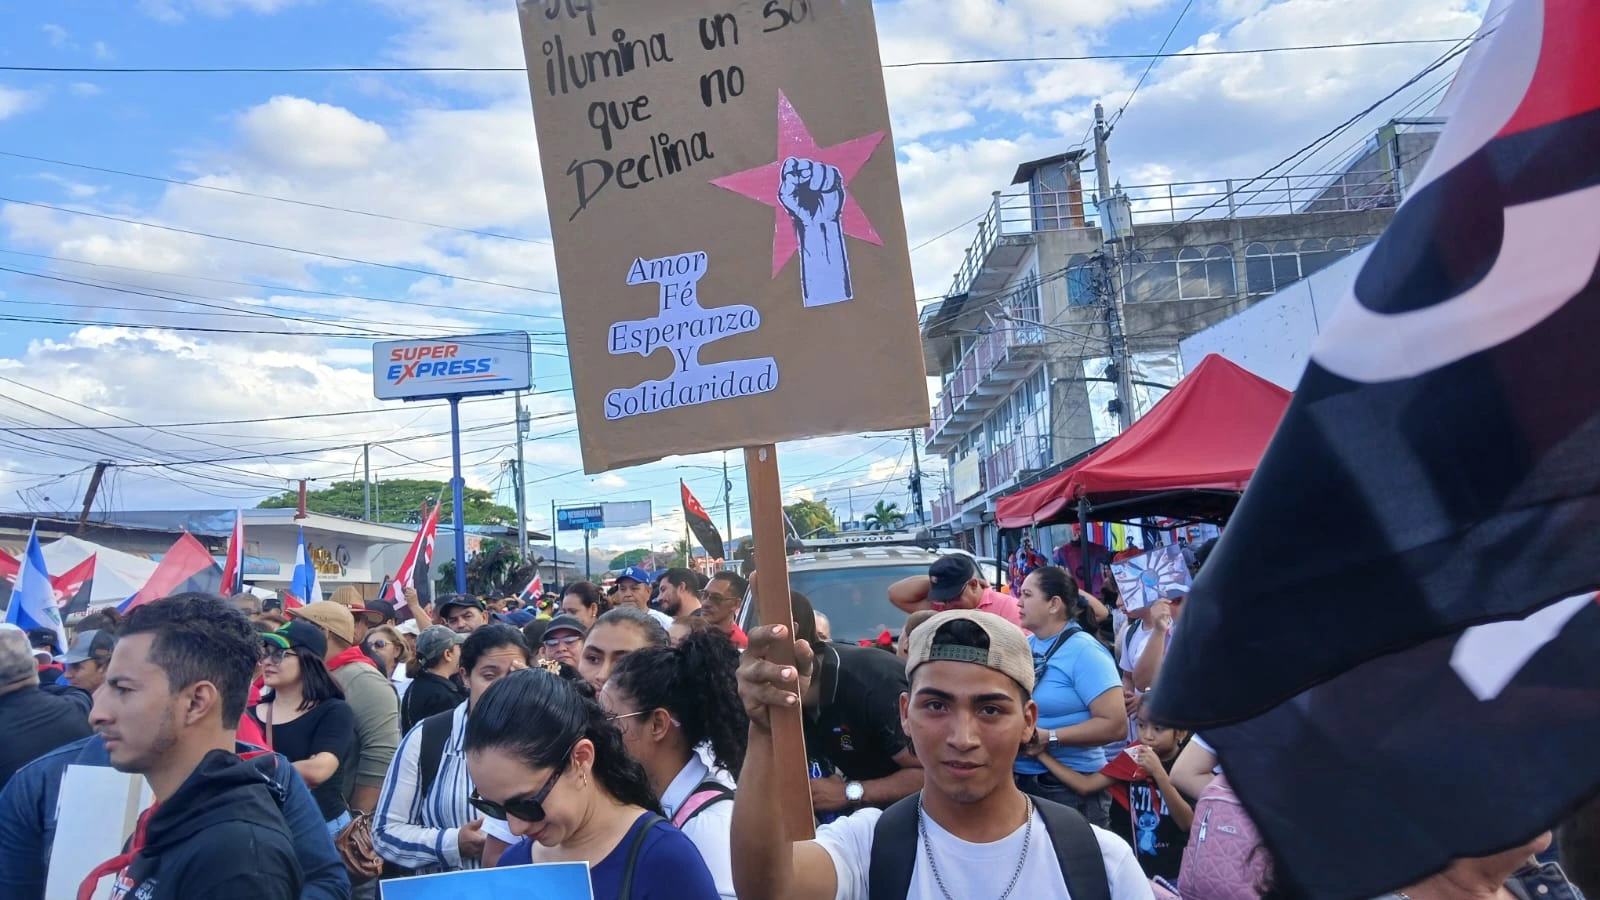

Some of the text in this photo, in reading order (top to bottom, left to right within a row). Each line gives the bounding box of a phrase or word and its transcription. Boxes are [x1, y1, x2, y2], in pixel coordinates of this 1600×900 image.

[541, 28, 674, 96] ilumina
[699, 12, 739, 51] un
[588, 65, 745, 151] que no
[566, 131, 714, 222] Declina
[628, 251, 706, 283] Amor
[663, 281, 694, 310] Fé
[611, 308, 757, 353] Esperanza
[390, 344, 459, 362] SUPER
[676, 346, 695, 373] Y
[387, 357, 492, 385] EXPRESS
[606, 364, 774, 418] Solidaridad
[845, 534, 894, 543] TOYOTA
